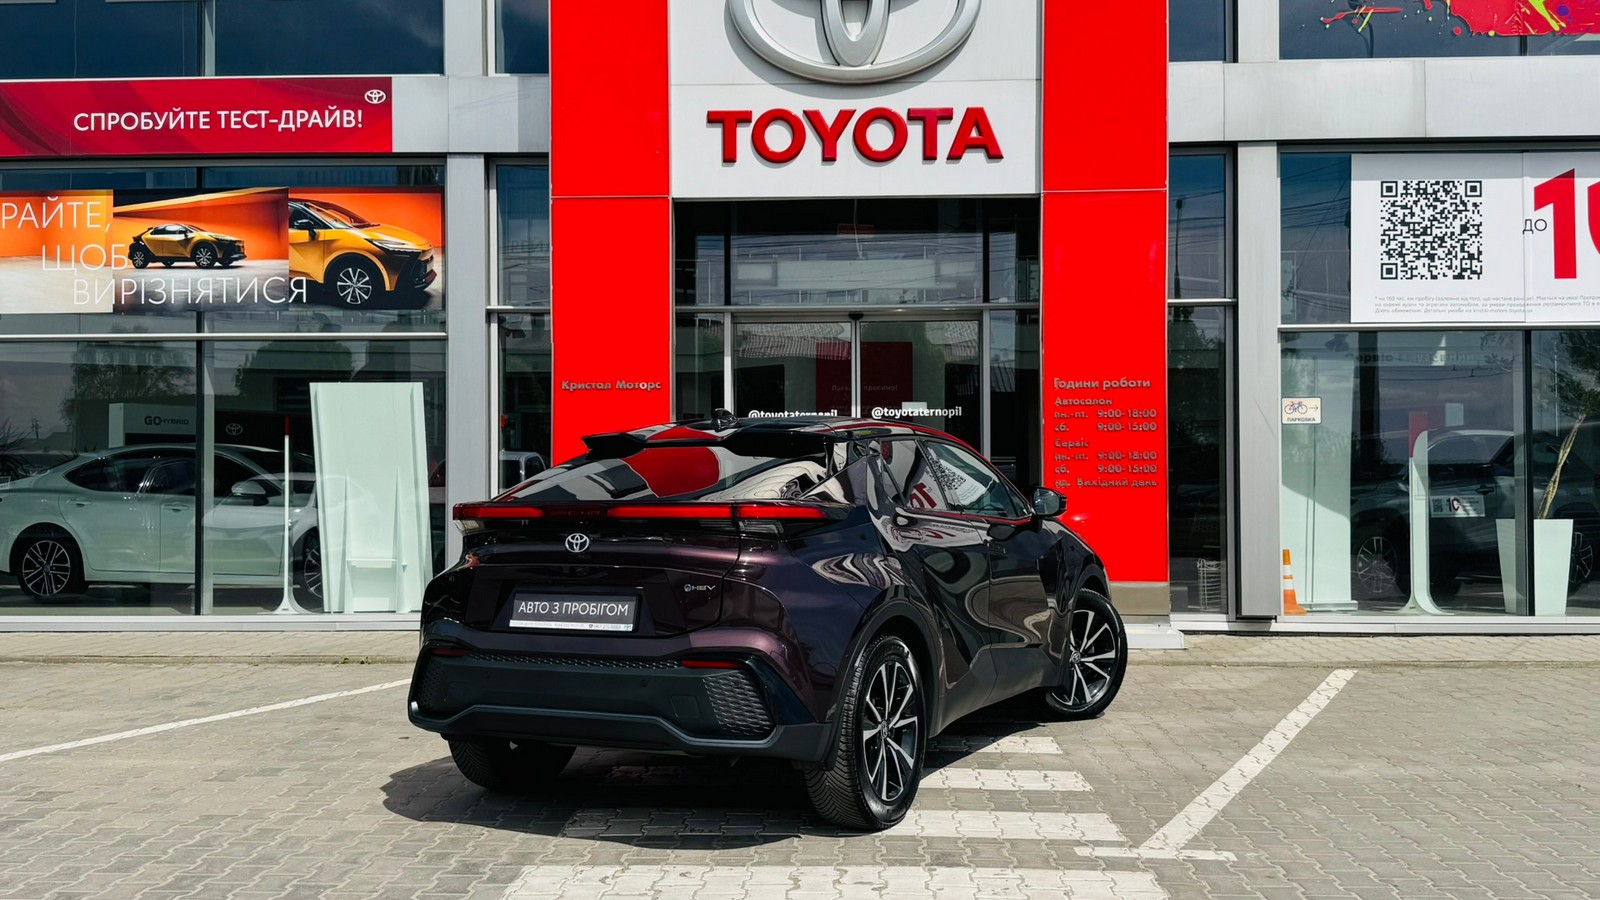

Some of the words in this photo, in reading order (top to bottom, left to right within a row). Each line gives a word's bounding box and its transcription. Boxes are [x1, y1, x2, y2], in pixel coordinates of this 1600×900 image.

[74, 106, 211, 131] СПРОБУЙТЕ
[217, 104, 363, 132] ТЕСТ-ДРАЙВ!
[706, 107, 1004, 163] TOYOTA
[1, 196, 111, 232] РАЙТЕ,
[42, 243, 129, 276] ЩОБ
[73, 276, 307, 305] ВИРІЗНЯТИСЯ
[561, 380, 612, 392] Кристал
[616, 380, 661, 392] Моторс
[1053, 377, 1099, 389] Години
[1103, 377, 1150, 391] роботи
[1055, 397, 1112, 406] Автосалон
[871, 406, 962, 419] @toyotaternopil
[1054, 422, 1069, 431] сб.
[1054, 438, 1089, 449] Сервіс
[1054, 464, 1070, 474] сб.
[1077, 477, 1129, 487] Вихідний
[518, 601, 550, 614] АВТО
[562, 602, 629, 616] ПРОБІГОМ
